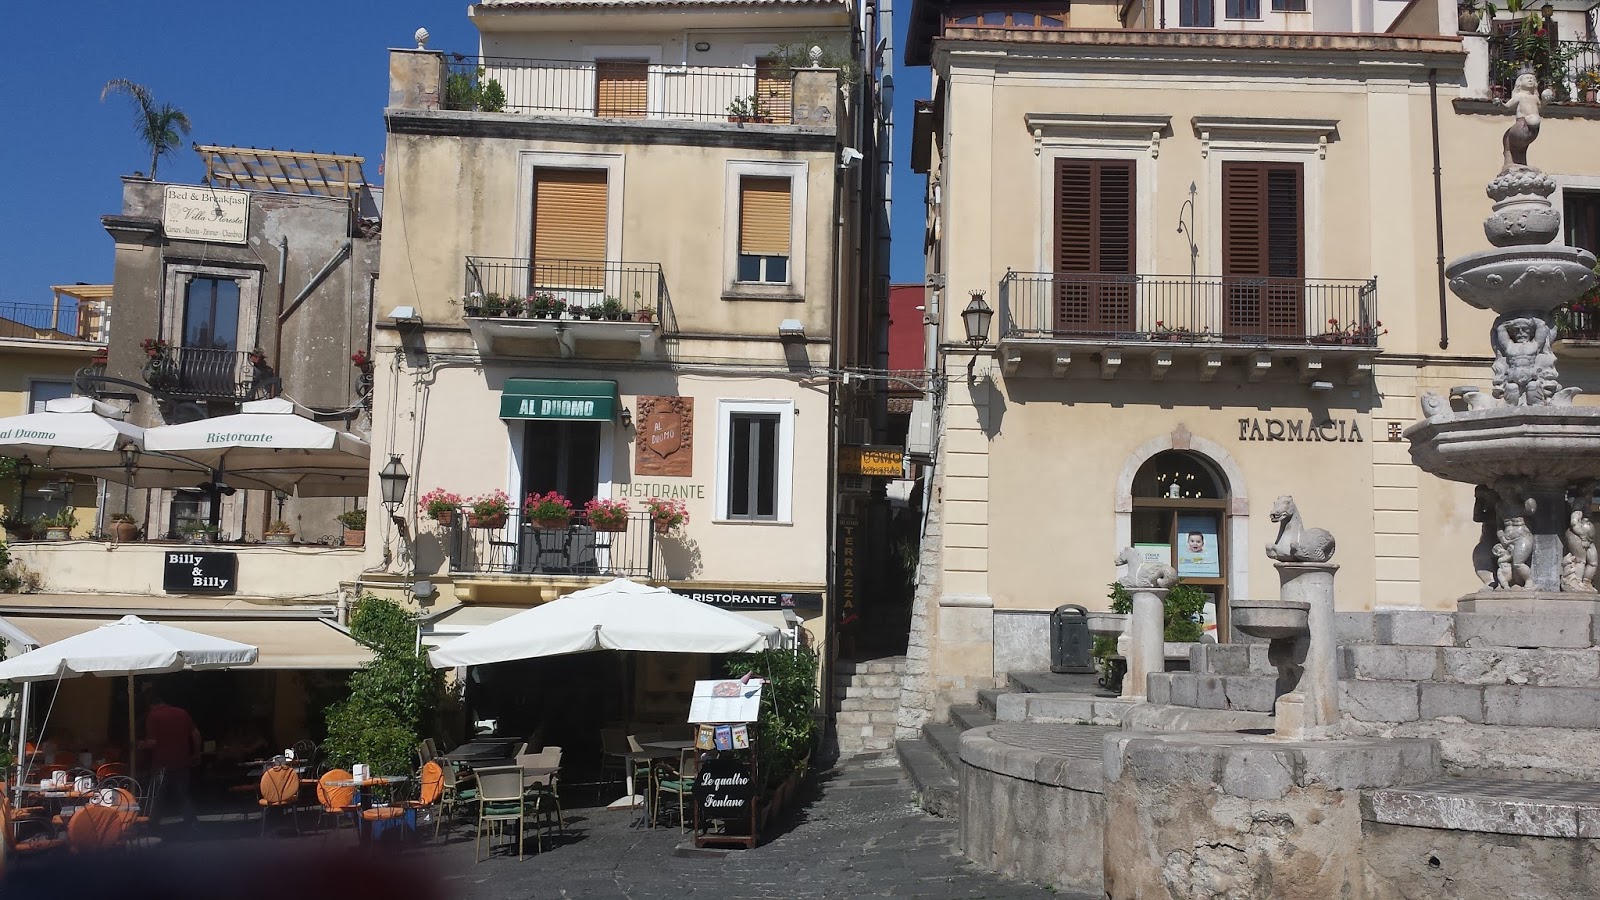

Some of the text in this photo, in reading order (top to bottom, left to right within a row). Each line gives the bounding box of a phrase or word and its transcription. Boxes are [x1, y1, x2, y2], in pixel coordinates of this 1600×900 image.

[168, 191, 187, 200] Bed
[190, 192, 199, 201] &
[182, 206, 243, 224] Villa Floresta
[519, 399, 594, 416] AL DUOMO
[654, 421, 663, 432] AL
[1238, 418, 1363, 442] FARMACIA
[0, 428, 56, 440] al Duomo
[206, 432, 273, 443] Ristorante
[651, 430, 675, 445] DUOMO
[619, 482, 705, 499] RISTORANTE
[169, 554, 203, 566] Billy
[192, 566, 203, 576] &
[844, 526, 853, 609] TERRAZZA
[192, 577, 228, 588] Billy
[692, 593, 777, 605] RISTORANTE
[701, 772, 749, 791] Le quattro
[704, 794, 745, 807] Fontane
